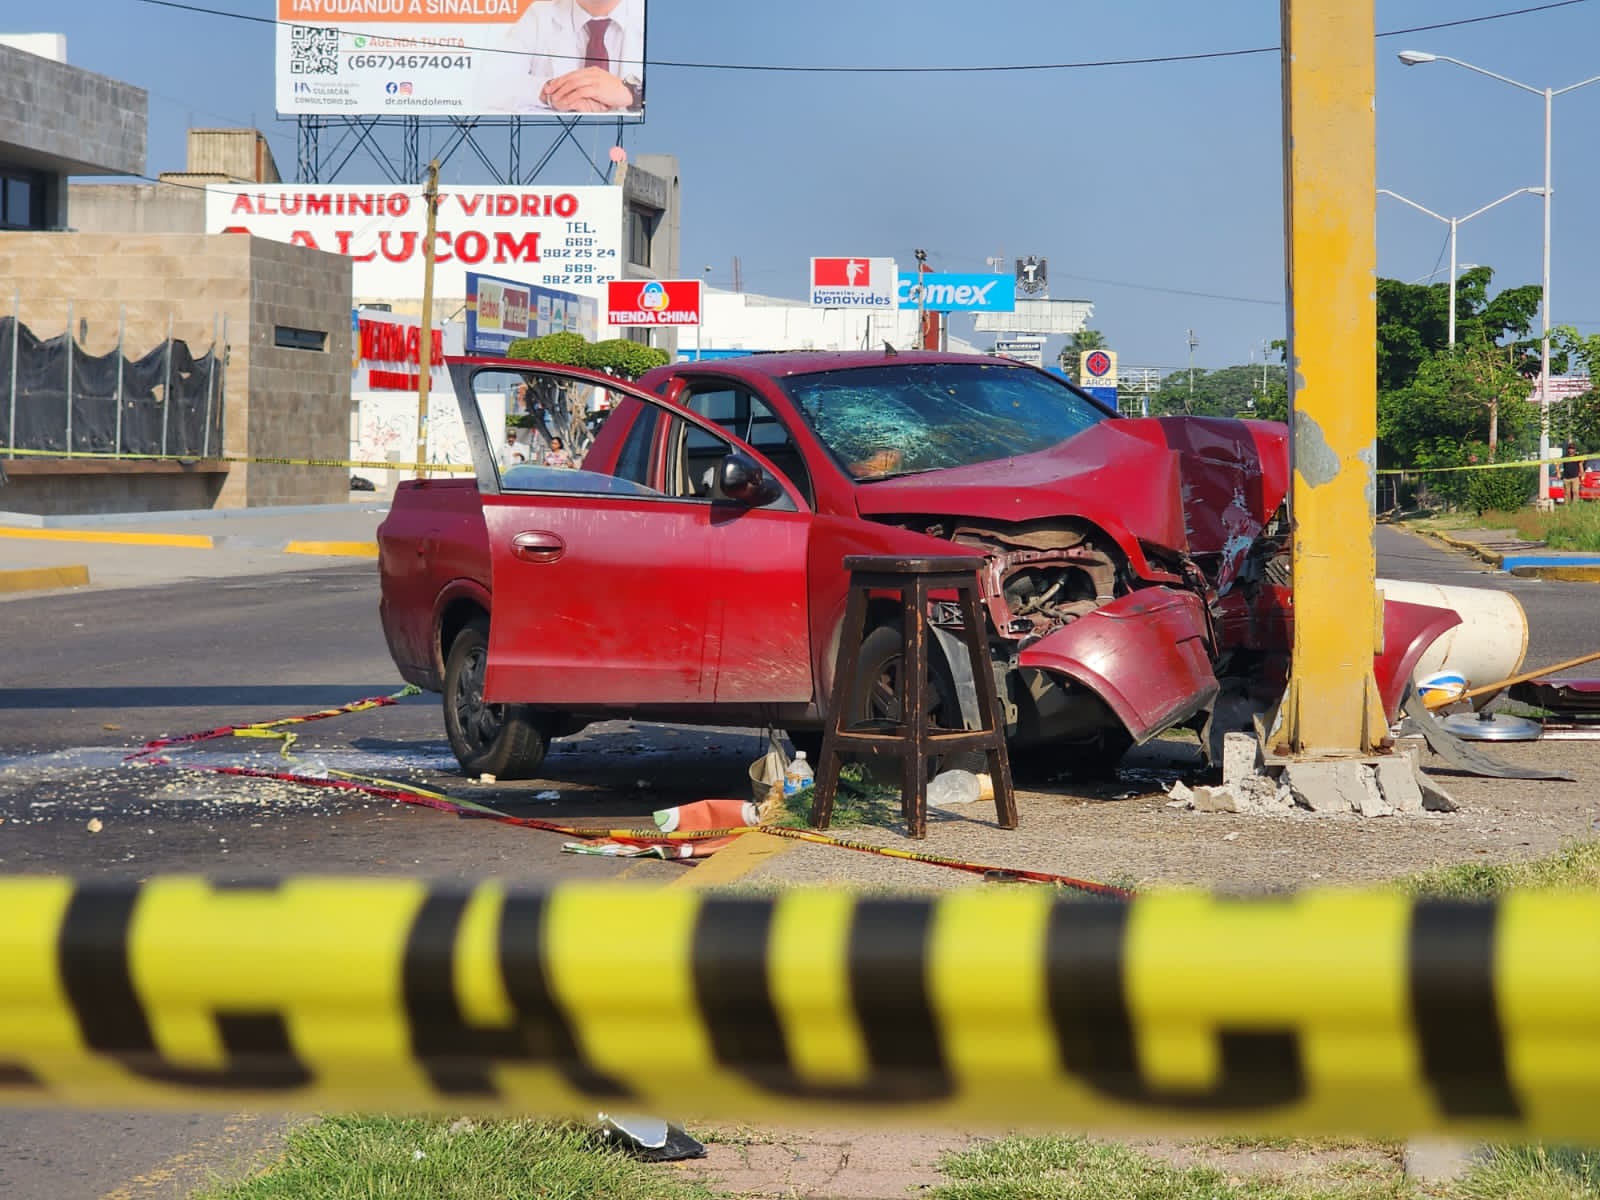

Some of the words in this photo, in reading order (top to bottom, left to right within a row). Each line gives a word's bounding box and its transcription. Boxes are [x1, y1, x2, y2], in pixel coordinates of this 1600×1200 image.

[408, 0, 422, 14] A
[426, 0, 519, 14] SINALOA!
[369, 38, 417, 48] AGENDA
[439, 38, 465, 48] CITA
[348, 55, 471, 69] (667)4674041
[231, 193, 411, 217] ALUMINIO
[455, 193, 579, 218] VIDRIO
[566, 222, 596, 234] TEL.
[543, 249, 571, 258] 982
[575, 249, 592, 258] 25
[596, 249, 616, 258] 24
[543, 275, 571, 284] 982
[574, 275, 593, 284] 28
[814, 292, 890, 304] benavides
[897, 279, 999, 306] Comex
[609, 311, 656, 323] TIENDA
[657, 311, 698, 323] CHINA
